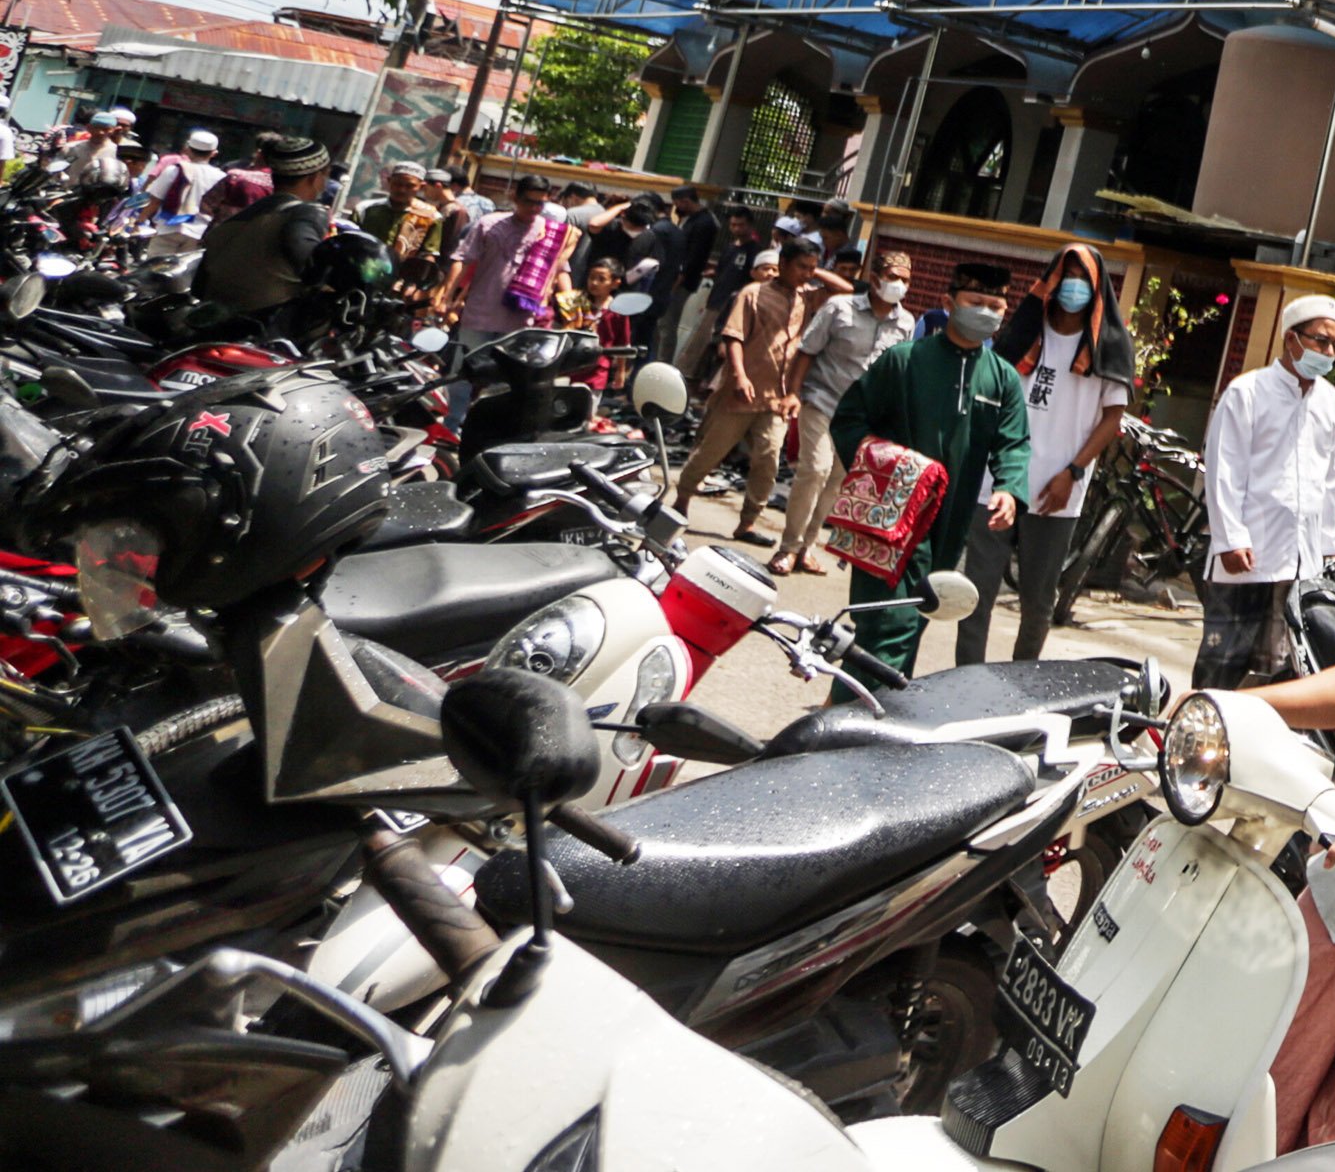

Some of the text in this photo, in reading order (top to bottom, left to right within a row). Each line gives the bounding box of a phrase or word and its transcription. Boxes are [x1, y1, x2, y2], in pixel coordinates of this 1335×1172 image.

[69, 733, 175, 865] KH 5307 YA
[1012, 957, 1057, 1026] 2833
[1056, 997, 1085, 1050] VK
